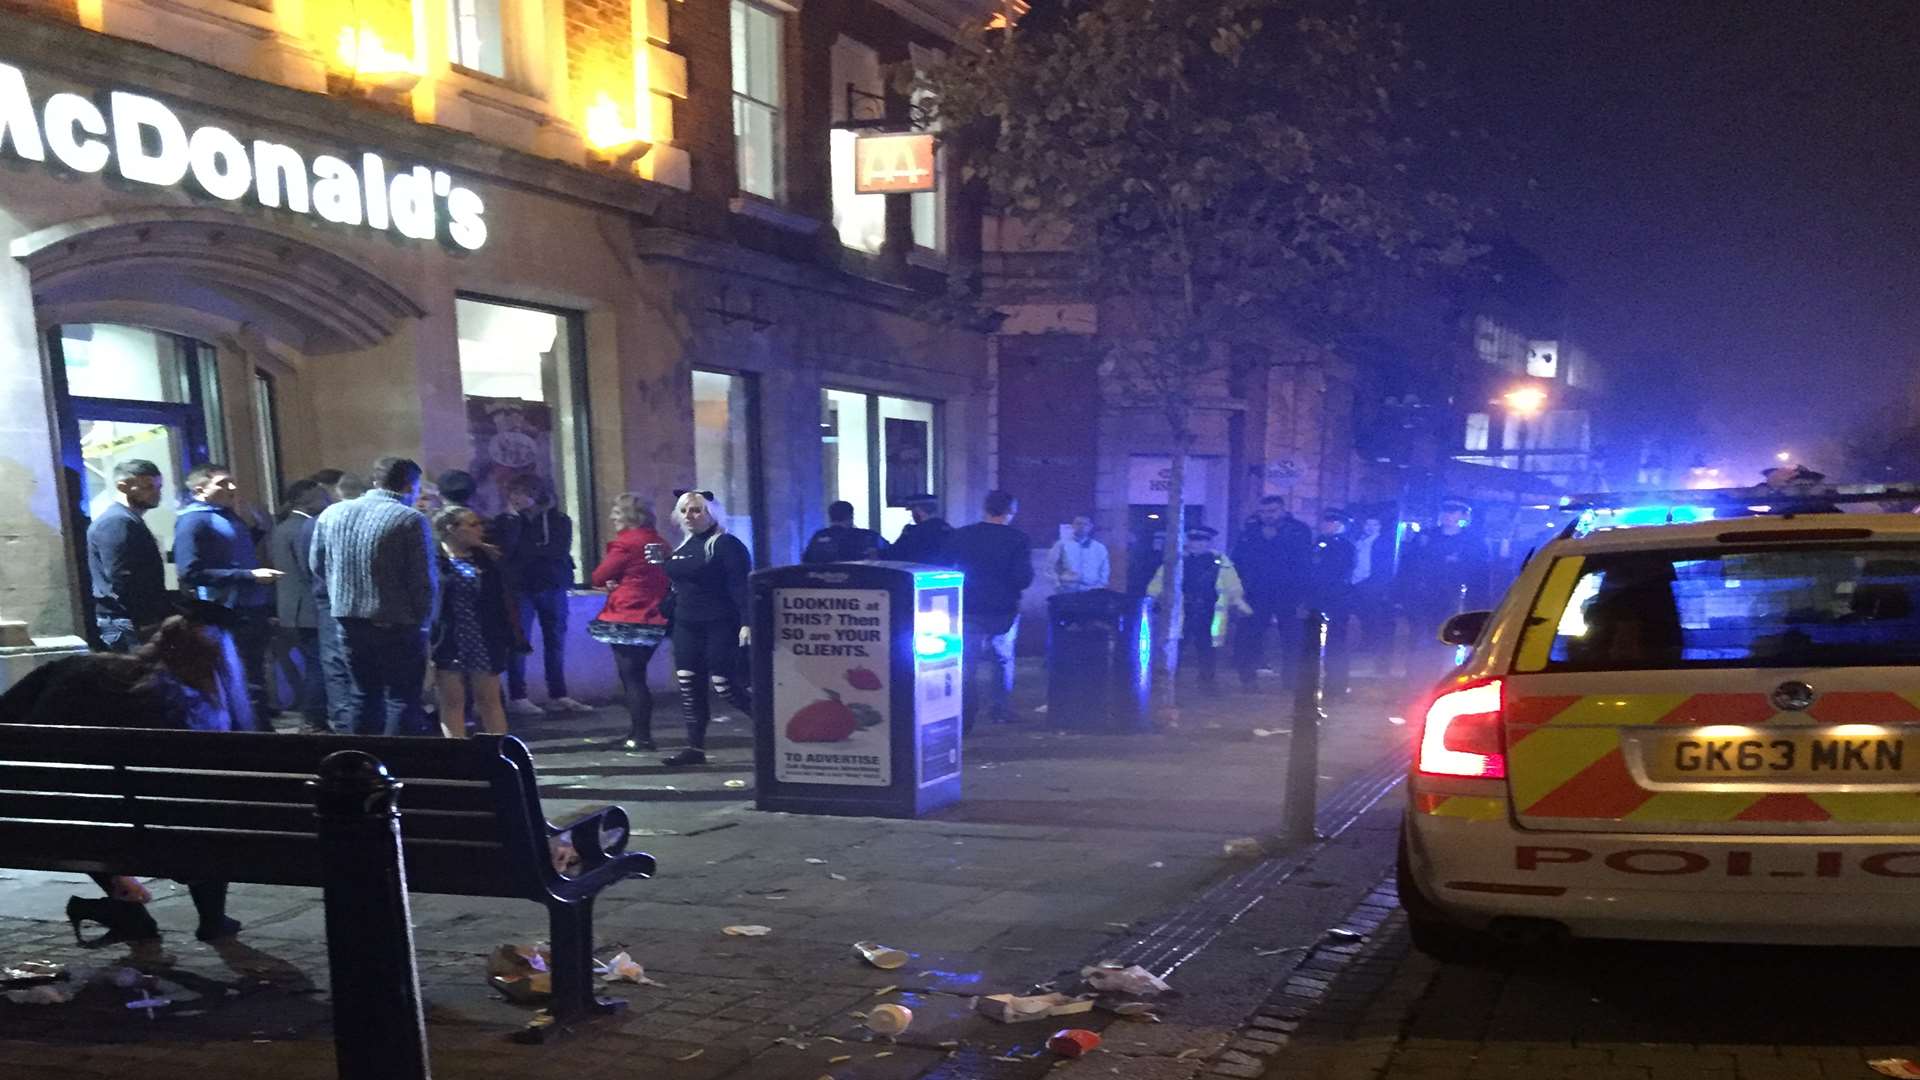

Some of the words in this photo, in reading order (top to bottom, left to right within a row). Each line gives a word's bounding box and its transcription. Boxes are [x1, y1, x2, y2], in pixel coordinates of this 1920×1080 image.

[783, 597, 860, 610] LOOKING
[866, 602, 880, 611] at
[782, 613, 832, 625] THIS?
[838, 614, 880, 626] Then
[781, 628, 804, 640] SO
[809, 633, 831, 641] are
[834, 629, 880, 642] YOUR
[792, 644, 869, 657] CLIENTS.
[784, 752, 802, 762] TO
[806, 754, 880, 765] ADVERTISE
[1676, 740, 1795, 772] GK63
[1811, 740, 1903, 772] MKN
